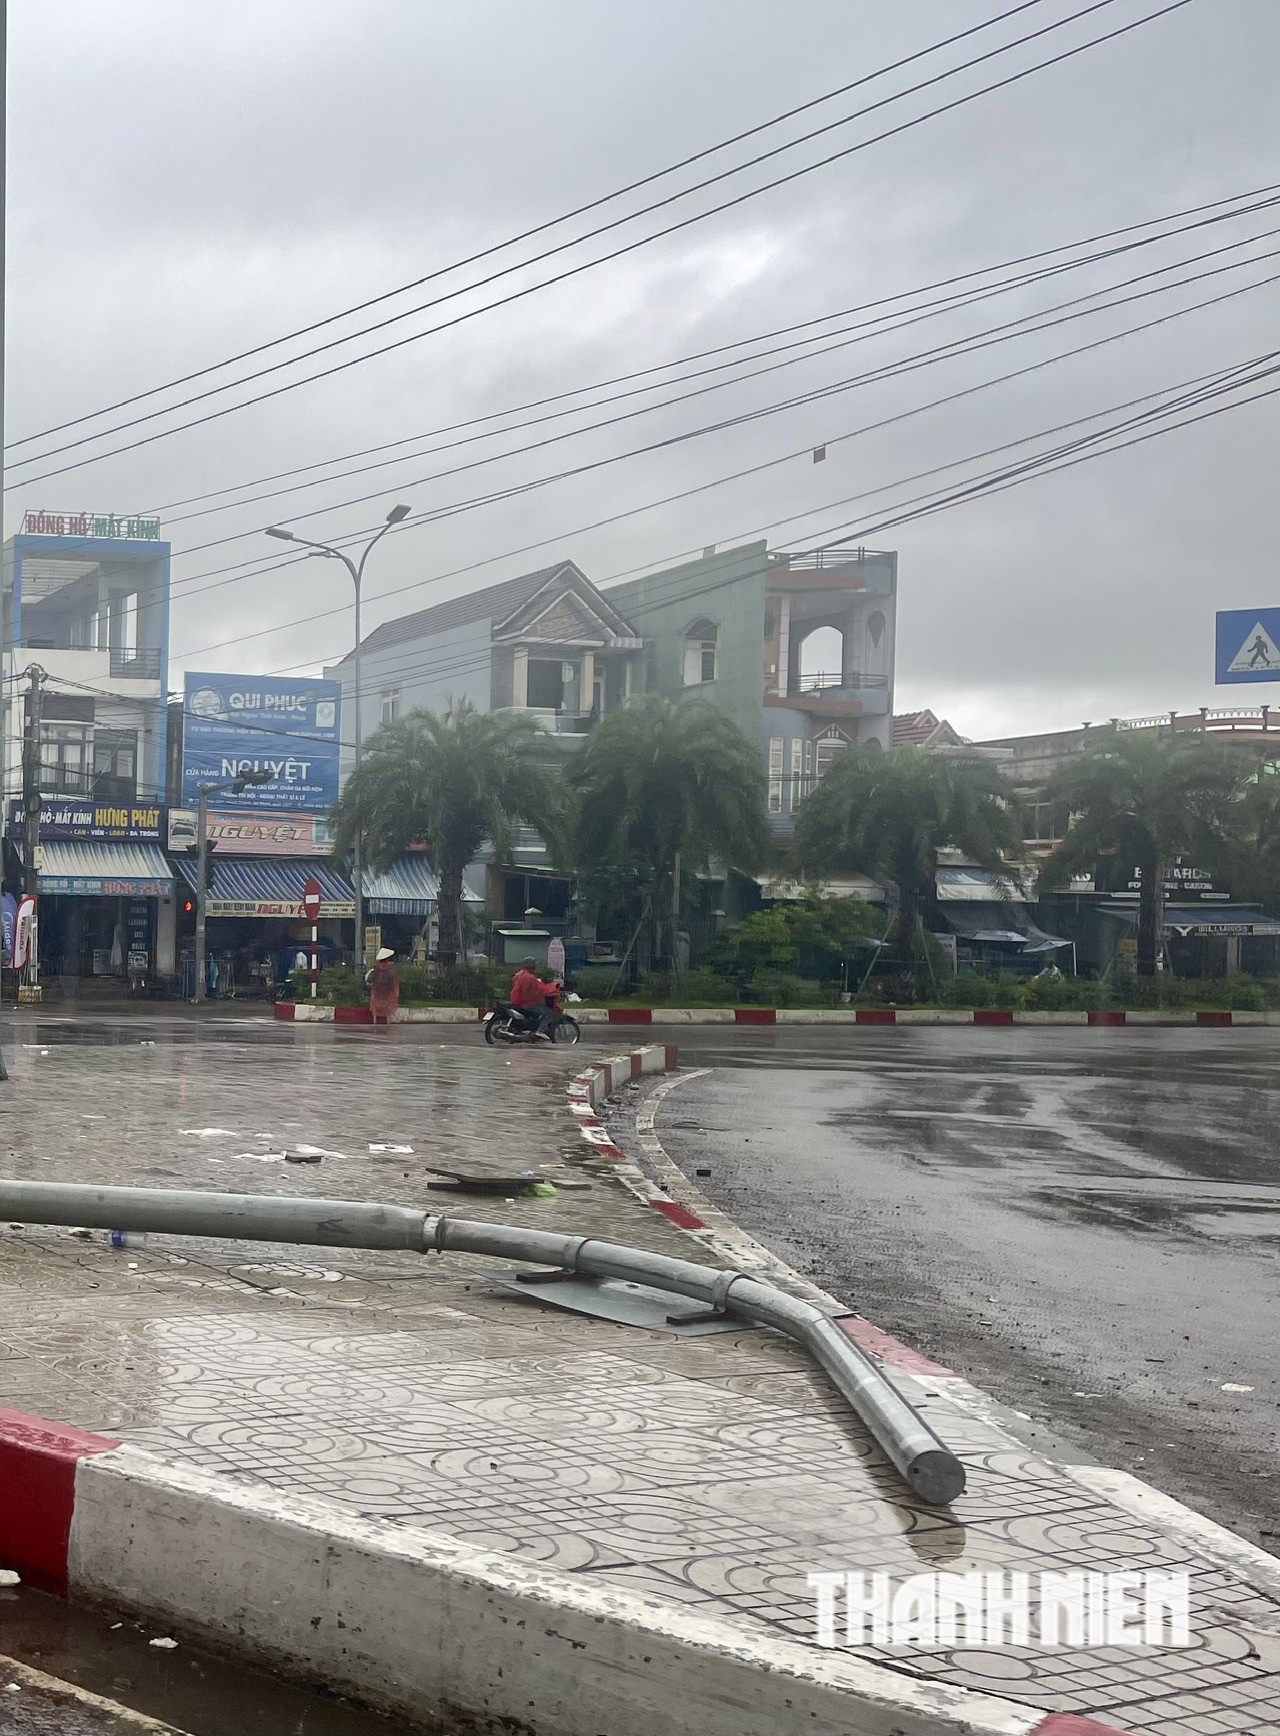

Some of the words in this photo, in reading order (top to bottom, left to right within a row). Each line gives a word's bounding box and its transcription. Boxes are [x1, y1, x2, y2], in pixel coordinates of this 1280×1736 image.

[229, 692, 261, 709] QUI
[72, 809, 92, 825] KÍNH
[95, 808, 128, 827] HƯNG
[132, 806, 160, 828] PHÁT
[256, 901, 306, 918] NGUYỆ
